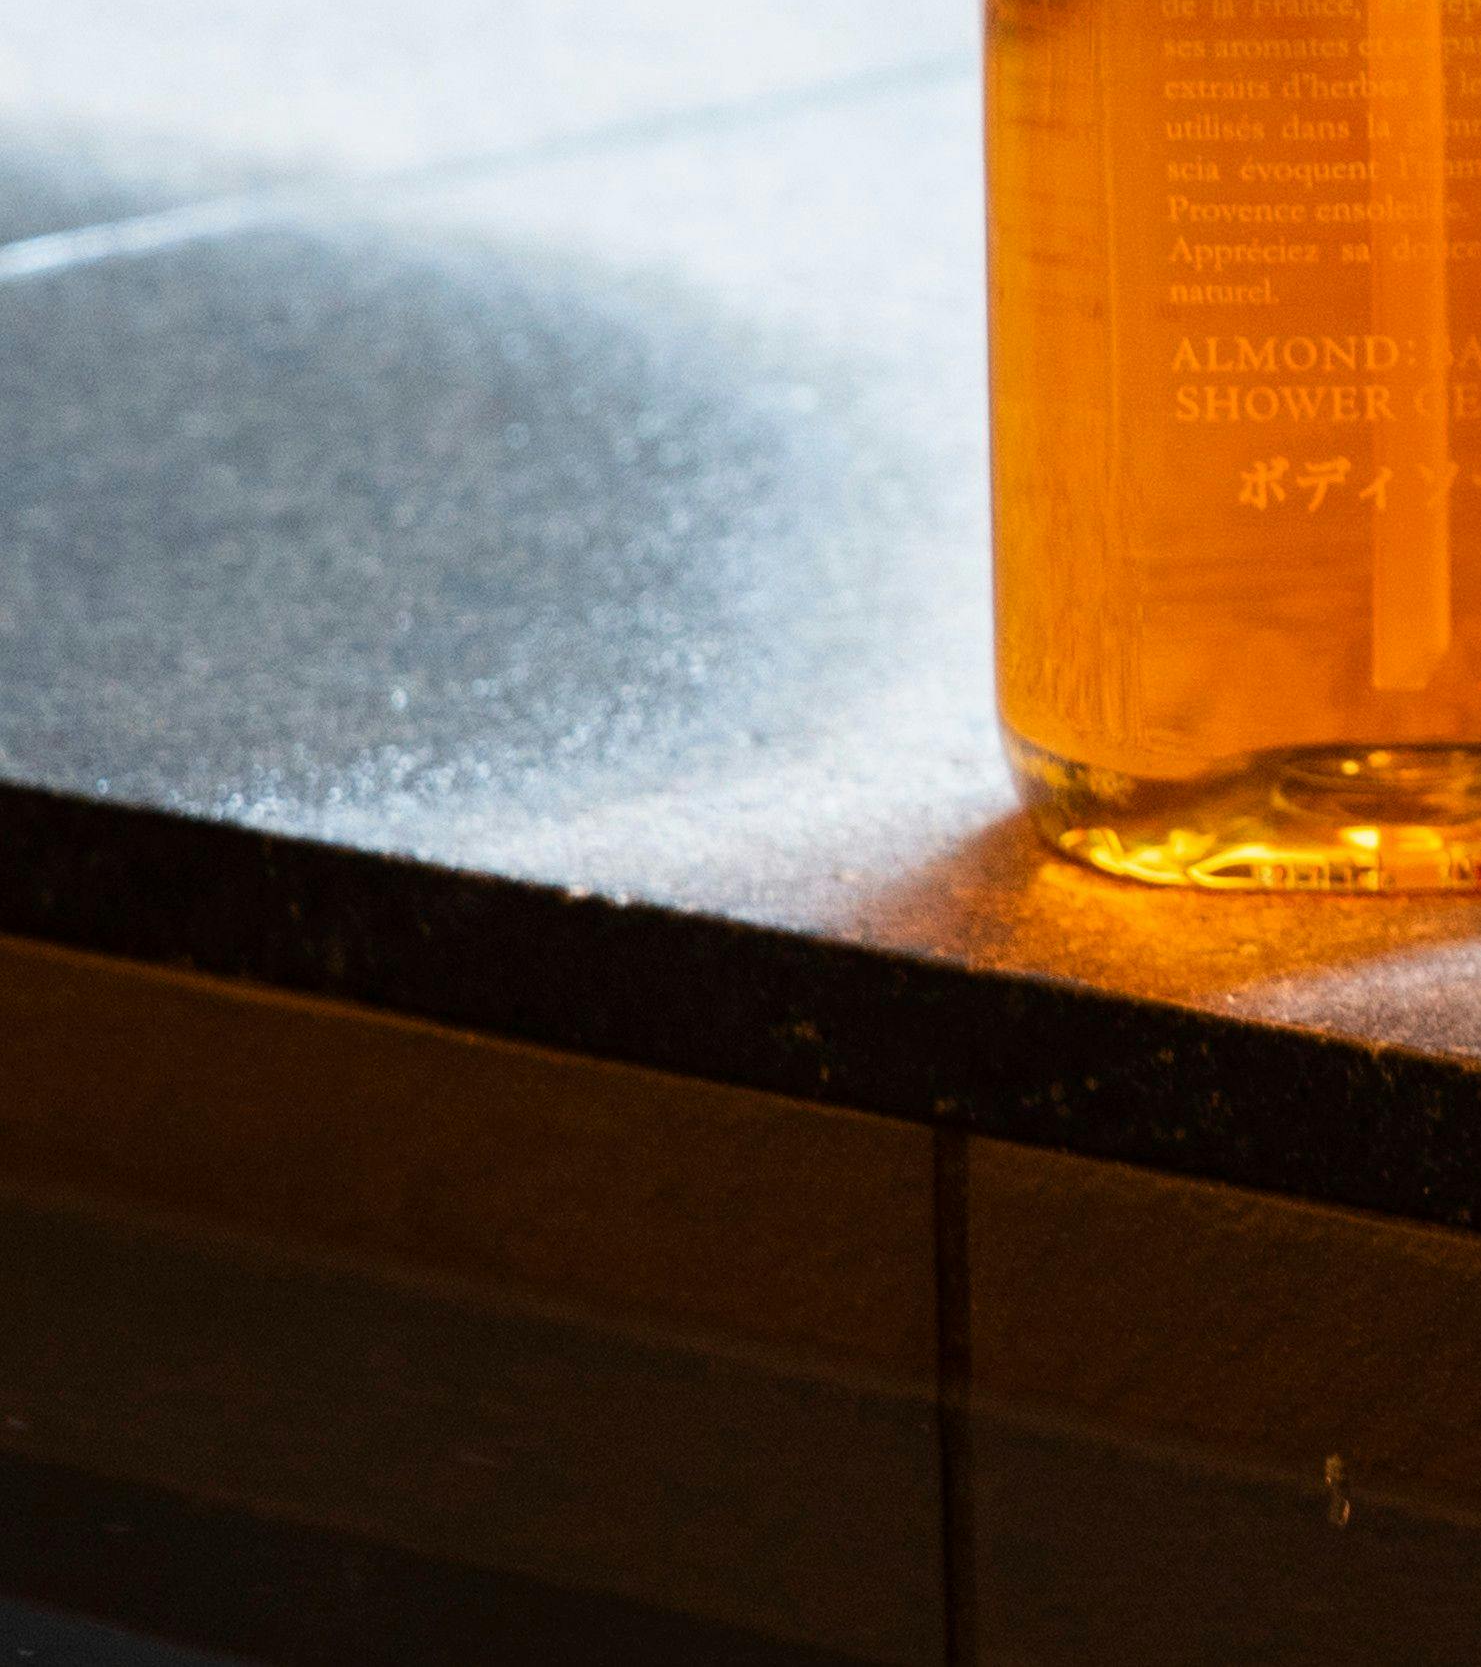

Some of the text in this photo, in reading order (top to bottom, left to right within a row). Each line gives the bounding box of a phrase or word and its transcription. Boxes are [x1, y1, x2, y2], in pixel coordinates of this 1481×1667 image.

[1167, 193, 1307, 223] Provence
[1170, 278, 1280, 305] naturel.
[1171, 335, 1418, 372] ALMOND:
[1175, 385, 1396, 421] SHOWER
